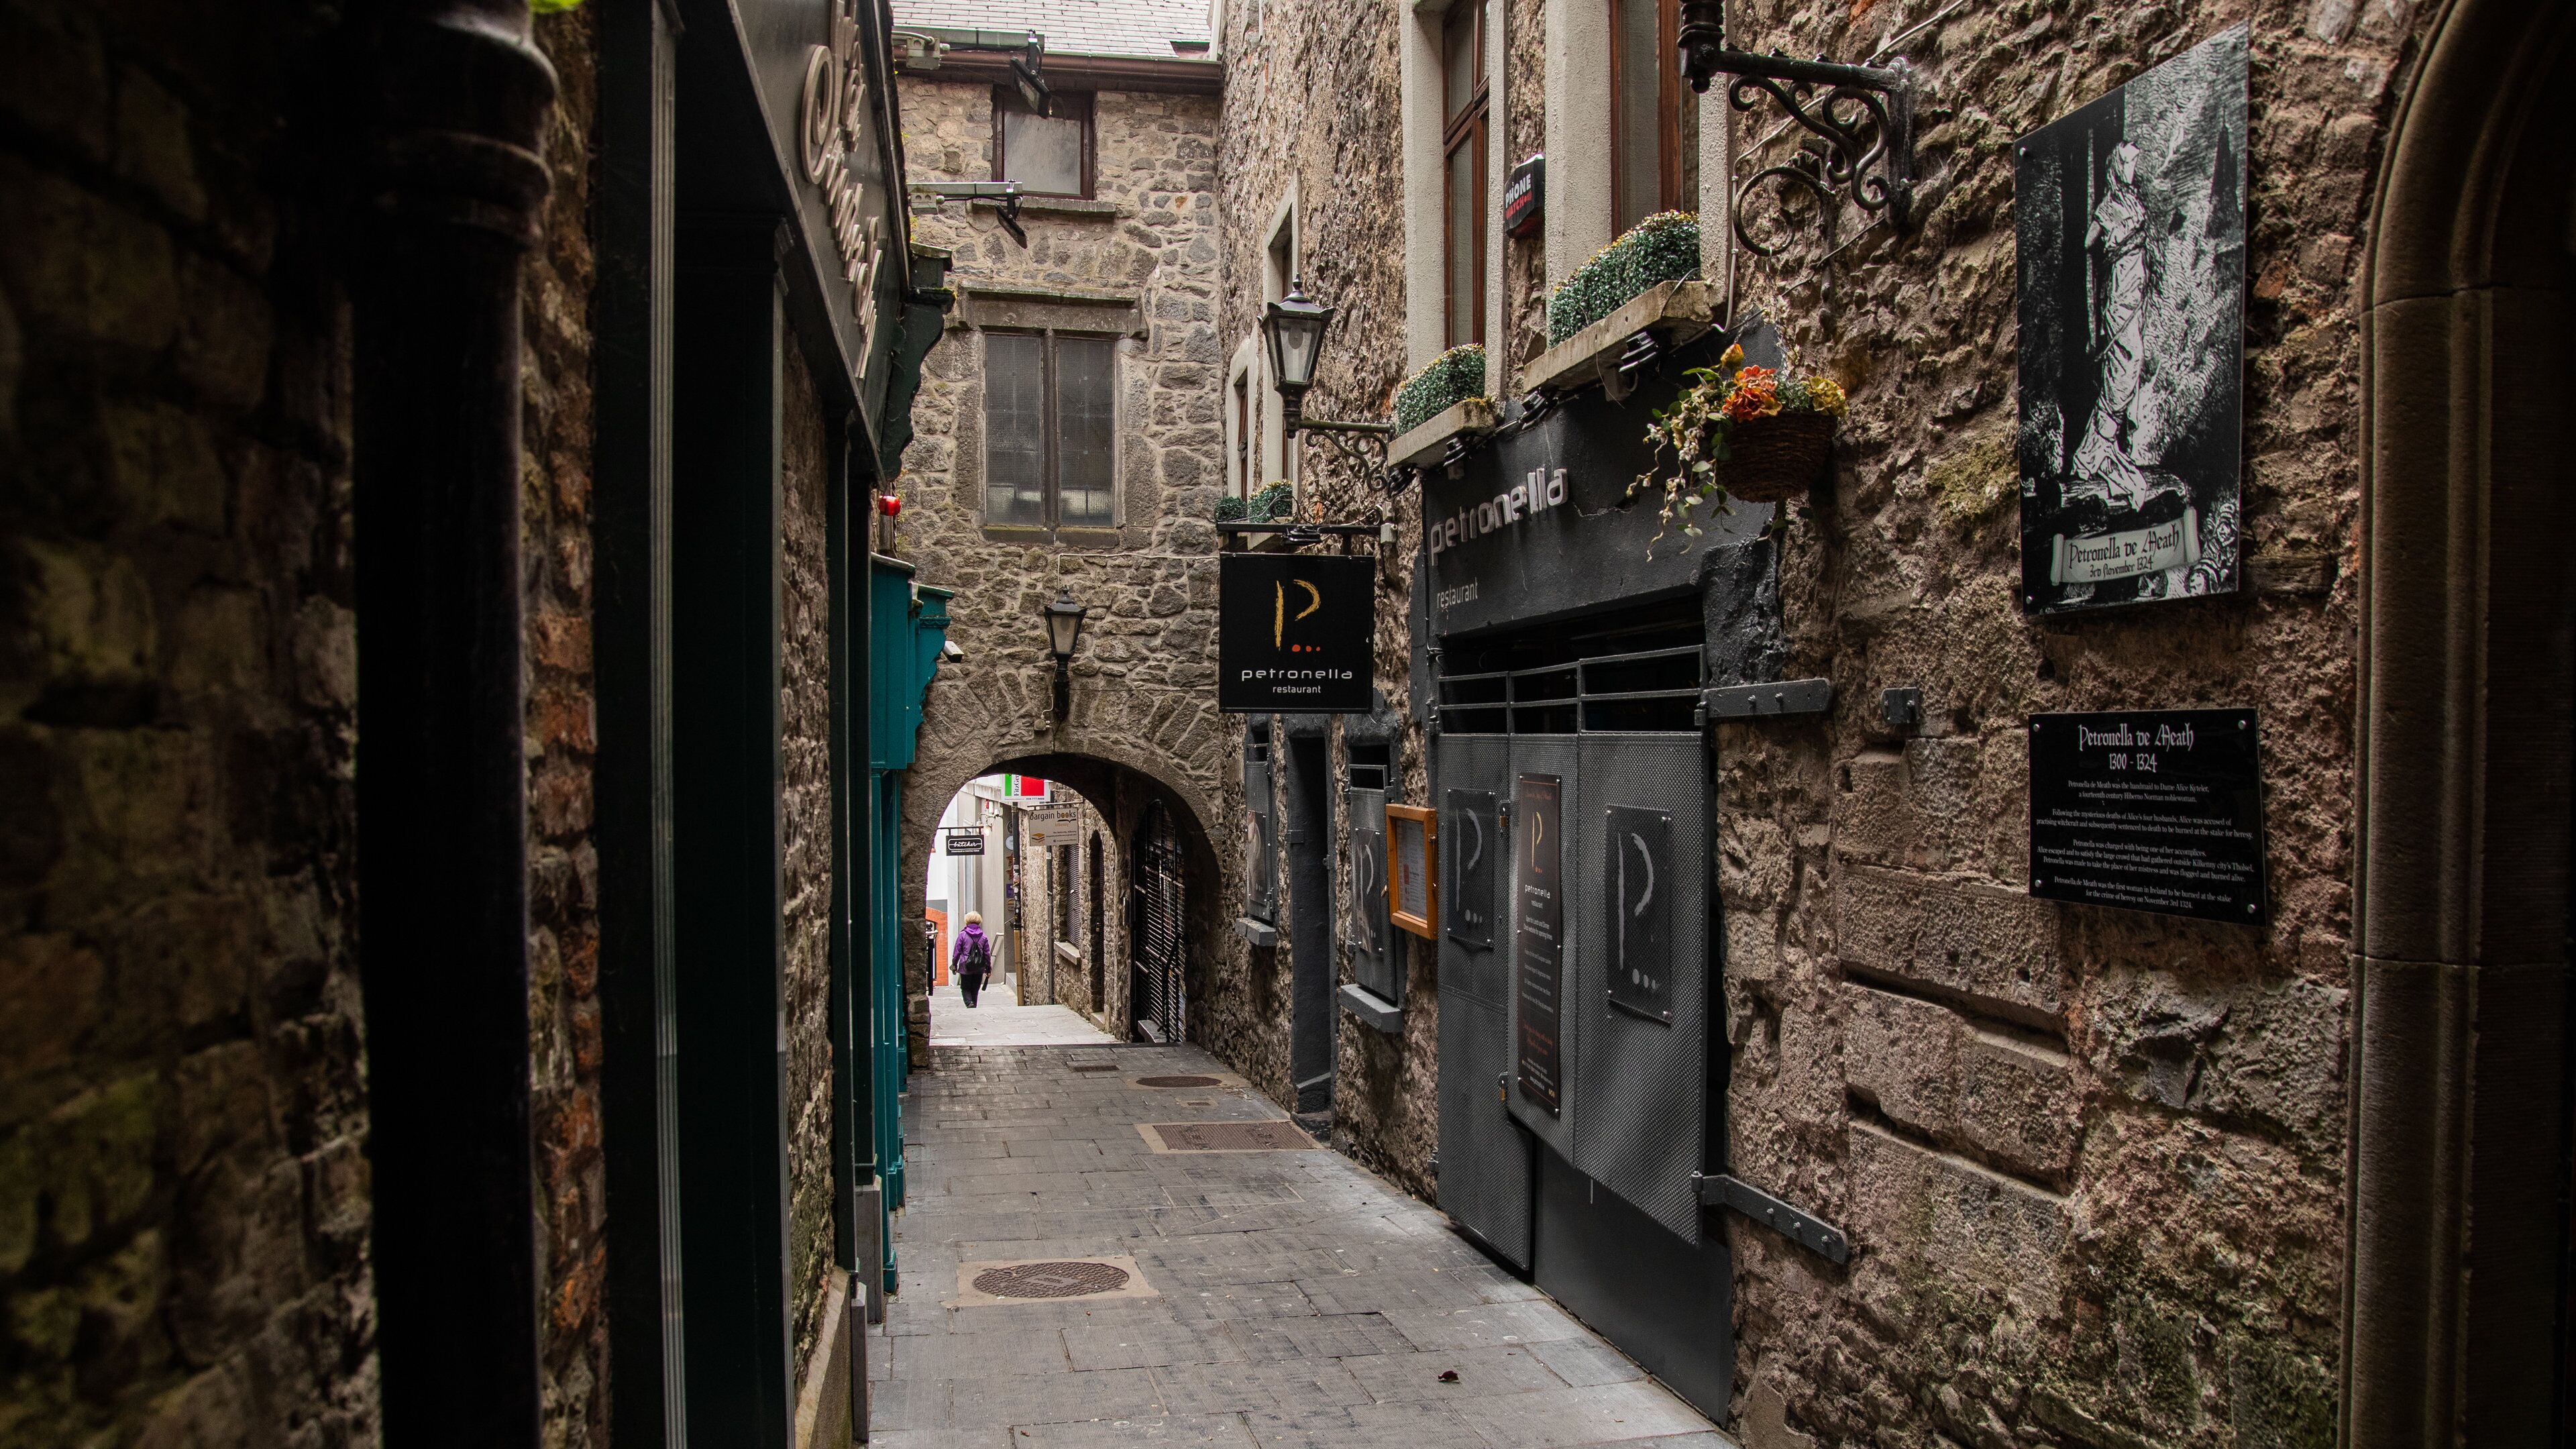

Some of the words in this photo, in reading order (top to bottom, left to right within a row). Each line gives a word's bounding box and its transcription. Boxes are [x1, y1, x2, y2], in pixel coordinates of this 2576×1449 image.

[1505, 174, 1531, 208] PHONE
[1430, 468, 1568, 567] petronella
[2069, 537, 2121, 569] Petronella
[2140, 524, 2180, 554] Meath
[2090, 565, 2102, 578] 3rd
[2102, 557, 2135, 580] November
[2136, 554, 2153, 571] 1324
[1436, 580, 1479, 609] restaurant
[1242, 668, 1353, 682] petronella
[1273, 685, 1322, 693] restaurant
[2078, 723, 2133, 751] Petronella
[2137, 731, 2150, 747] de
[2154, 722, 2194, 752] Meath
[2109, 753, 2127, 770] 1300
[2136, 753, 2157, 773] 1324
[2068, 780, 2090, 788] Petronella
[2130, 782, 2153, 790] handmaid
[1030, 812, 1054, 821] bargain
[1057, 810, 1076, 818] books
[2053, 809, 2073, 818] Following
[2106, 812, 2121, 820] deaths
[2180, 816, 2192, 824] Alice
[2037, 818, 2057, 826] practising
[2088, 821, 2118, 830] subsequently
[2147, 824, 2161, 833] death
[2074, 839, 2095, 847] Petronella
[2105, 842, 2123, 851] charged
[2136, 845, 2149, 853] being
[2043, 856, 2064, 864] Petronella
[2180, 869, 2199, 878] flogged
[2211, 871, 2230, 881] burned
[2080, 850, 2094, 859] satisfy
[2104, 851, 2114, 860] large
[2131, 853, 2140, 861] that
[2174, 858, 2192, 866] outside
[2192, 859, 2216, 869] Kilkenny
[1525, 884, 1550, 899] petronella
[2055, 875, 2076, 885] Petronella
[2150, 885, 2167, 895] Ireland
[2174, 888, 2180, 896] be
[2182, 890, 2200, 899] burned
[2207, 892, 2215, 901] the
[2101, 891, 2114, 899] crime
[2121, 893, 2136, 902] heresy
[2145, 896, 2169, 906] November
